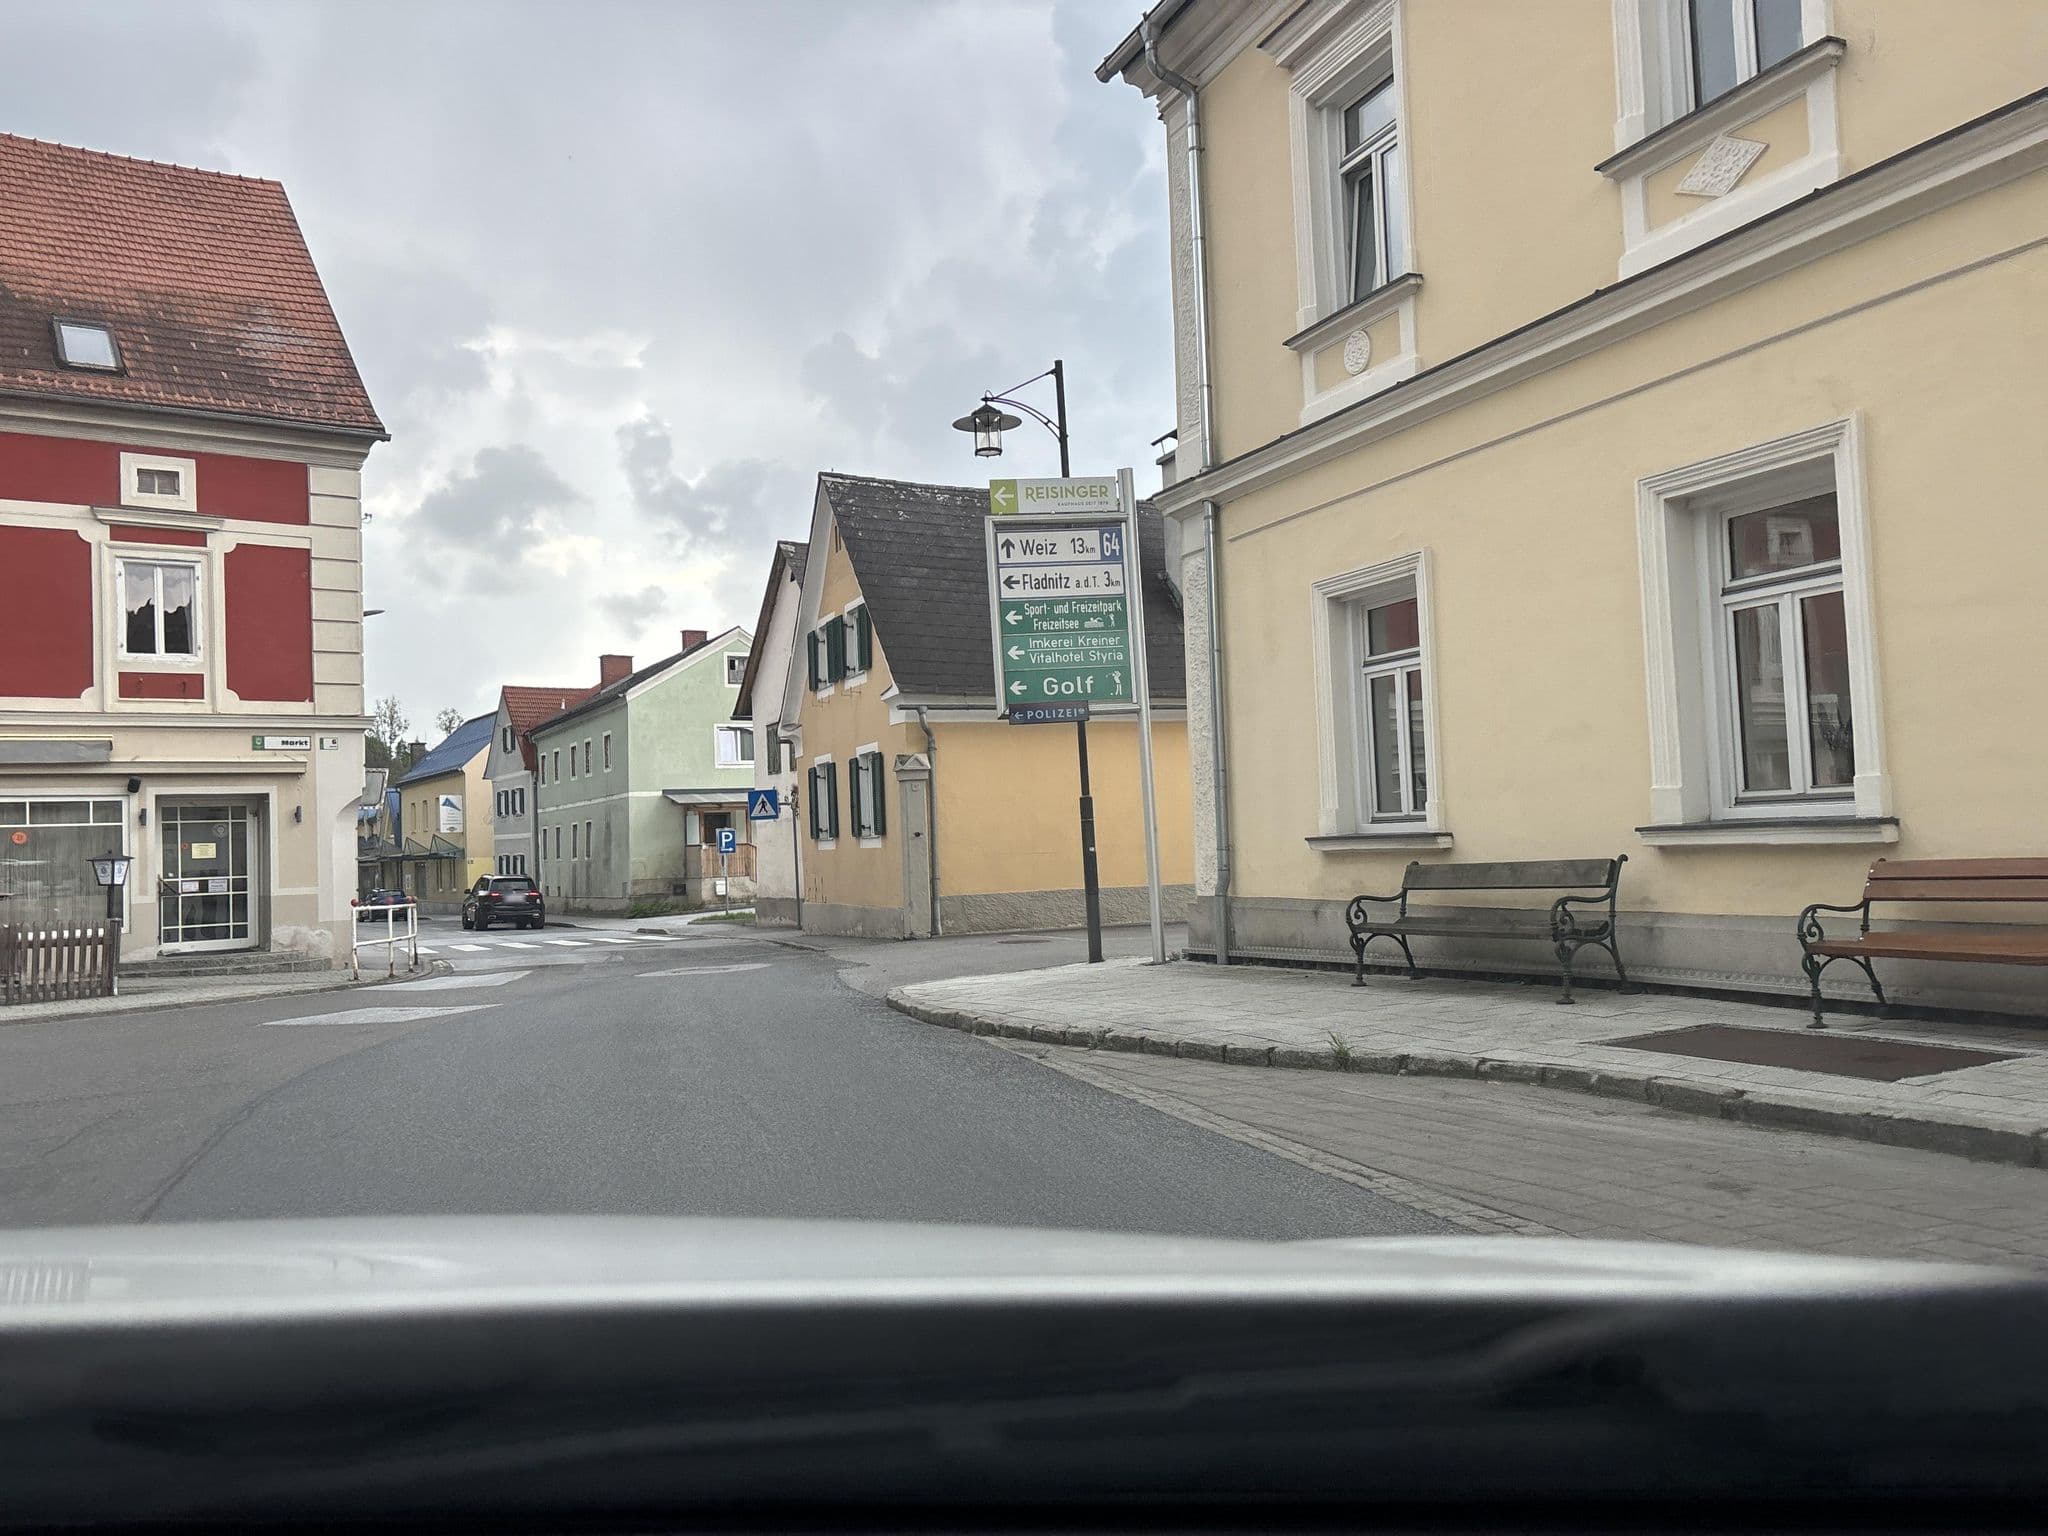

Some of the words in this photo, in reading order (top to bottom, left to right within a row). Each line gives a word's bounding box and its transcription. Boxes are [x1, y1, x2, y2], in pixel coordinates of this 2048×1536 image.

[1025, 485, 1109, 502] REISINGER
[1020, 539, 1057, 555] Weiz
[1103, 532, 1120, 556] 64
[1022, 572, 1070, 590] Fladnitz
[1024, 603, 1051, 618] Sport-
[1054, 602, 1069, 614] und
[1072, 600, 1122, 615] Freizeitpark
[1033, 618, 1080, 630] Freizeitsee
[1029, 636, 1073, 648] Imkerei
[1078, 636, 1120, 647] Kreiner
[1030, 651, 1084, 664] Vitalhotel
[1088, 649, 1123, 663] Styria
[1043, 676, 1094, 695] Golf
[1027, 708, 1077, 720] POLIZEI
[721, 832, 733, 848] P
